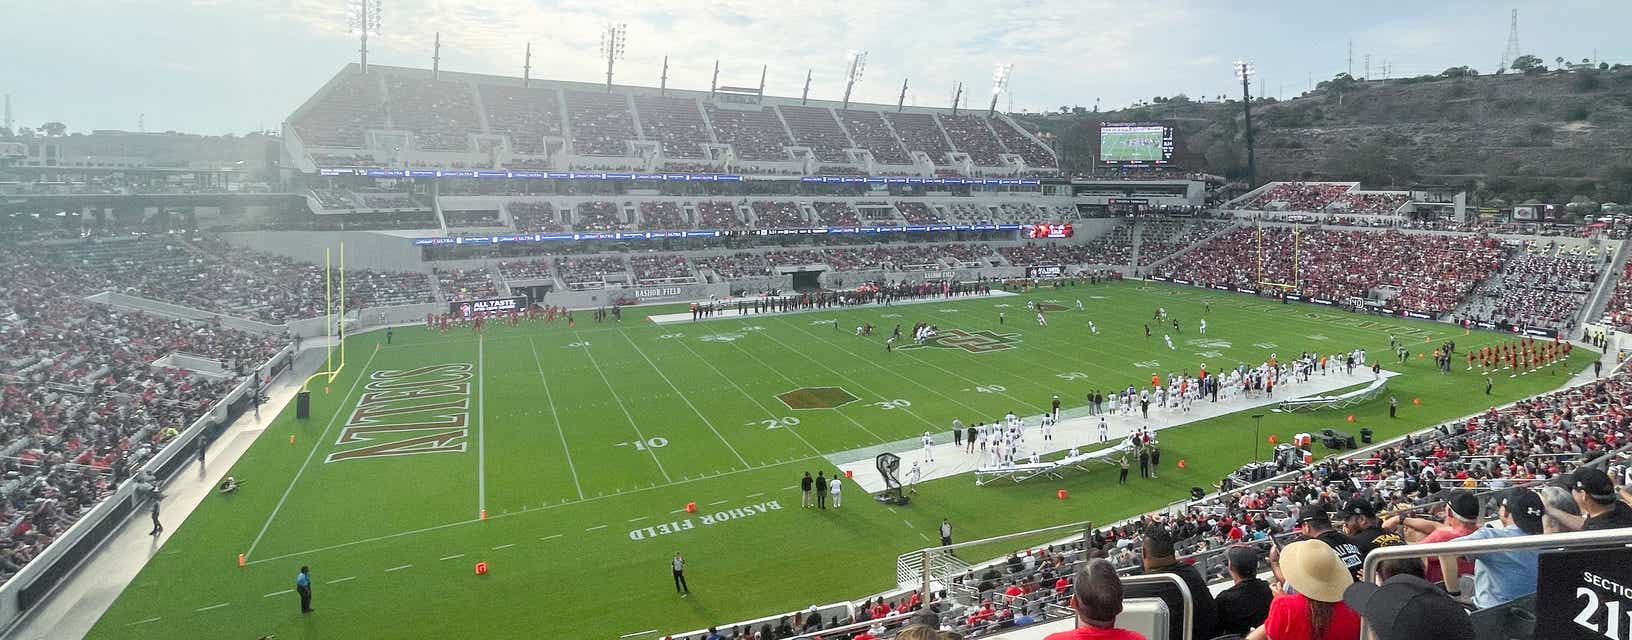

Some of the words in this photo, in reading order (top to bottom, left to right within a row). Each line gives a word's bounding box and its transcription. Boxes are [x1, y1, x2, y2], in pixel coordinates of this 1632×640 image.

[324, 362, 474, 464] AZTECS
[761, 415, 801, 431] 20
[632, 436, 669, 451] 10
[698, 499, 784, 526] BASHOR
[628, 518, 696, 541] FIELD
